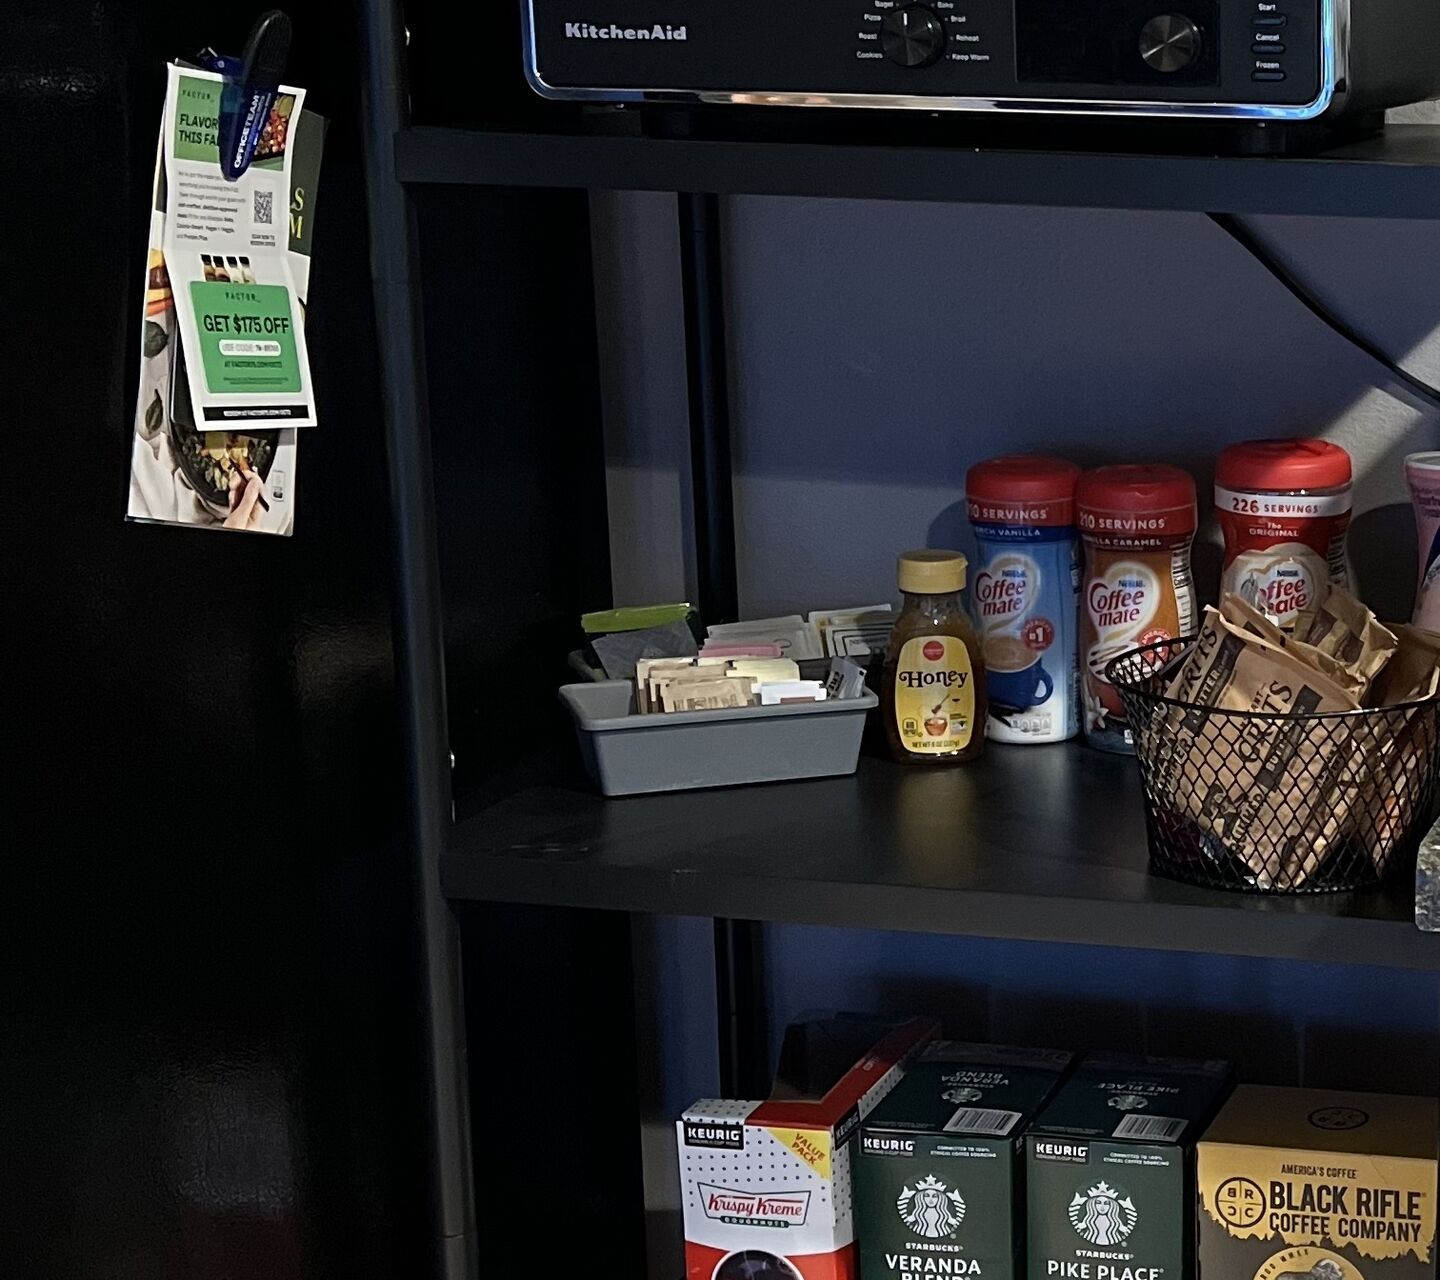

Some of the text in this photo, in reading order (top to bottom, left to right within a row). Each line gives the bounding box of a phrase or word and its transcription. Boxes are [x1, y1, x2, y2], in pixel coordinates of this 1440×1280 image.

[1258, 2, 1276, 11] Start
[565, 22, 687, 40] KitchenAid
[1255, 33, 1280, 41] Cancel
[1255, 61, 1280, 69] Frozen
[178, 129, 202, 144] THIS
[203, 313, 289, 335] GET $175 OFF
[1232, 497, 1319, 514] 226 SERVINGS
[983, 508, 1047, 521] SERVINGS
[1099, 518, 1165, 530] SERVINGS
[1267, 521, 1282, 530] The
[998, 527, 1041, 537] VANILLA
[1249, 527, 1299, 537] ORIGINAL
[1112, 538, 1162, 547] CARAMEL
[975, 572, 1026, 603] Coffee
[1090, 582, 1144, 613] Coffee
[983, 597, 1022, 616] mate
[1099, 607, 1140, 627] mate
[899, 670, 968, 688] Honey
[688, 1127, 740, 1141] KEURIG
[795, 1133, 826, 1161] VALUE
[864, 1138, 915, 1151] KEURIG
[1036, 1143, 1088, 1157] KEURIG
[791, 1141, 817, 1165] PACK
[1281, 1164, 1357, 1179] AMERICA'S COFFEE
[708, 1193, 804, 1217] Krispy Kreme
[1269, 1181, 1421, 1220] BLACK RIFLE
[1269, 1212, 1421, 1243] COFFEE COMPANY
[905, 1242, 960, 1252] STARBUCKS
[1075, 1249, 1130, 1260] STARBUCKS
[885, 1253, 982, 1275] VERANDA
[1047, 1260, 1090, 1279] PIKE
